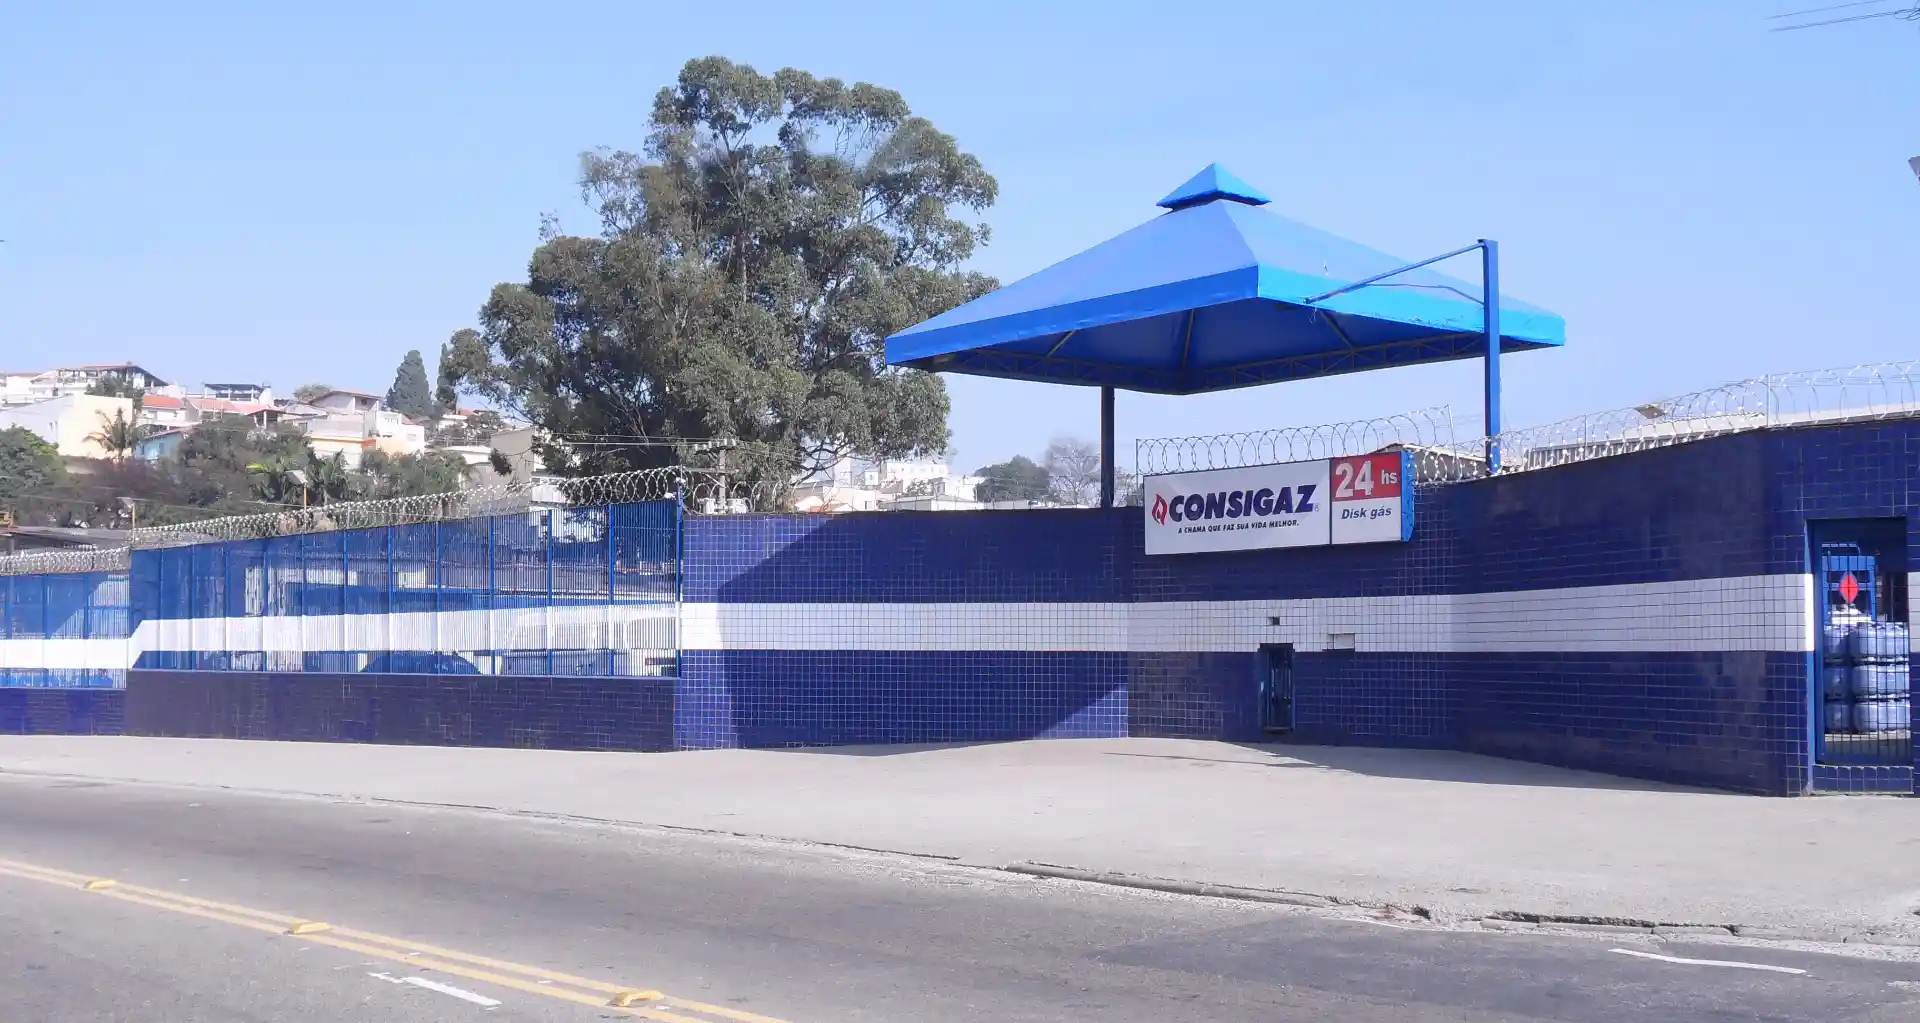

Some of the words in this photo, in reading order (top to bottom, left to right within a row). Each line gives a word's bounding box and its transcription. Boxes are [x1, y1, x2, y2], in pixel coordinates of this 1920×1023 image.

[1335, 460, 1374, 498] 24
[1381, 469, 1398, 485] hs
[1169, 484, 1317, 523] CONSIGAZ
[1341, 507, 1368, 519] Disk
[1369, 505, 1392, 519] gás
[1184, 525, 1206, 534] CHAMA
[1207, 524, 1221, 532] QUE
[1236, 522, 1249, 530] SUA
[1252, 521, 1267, 529] VIDA
[1269, 519, 1299, 528] MELHOR.
